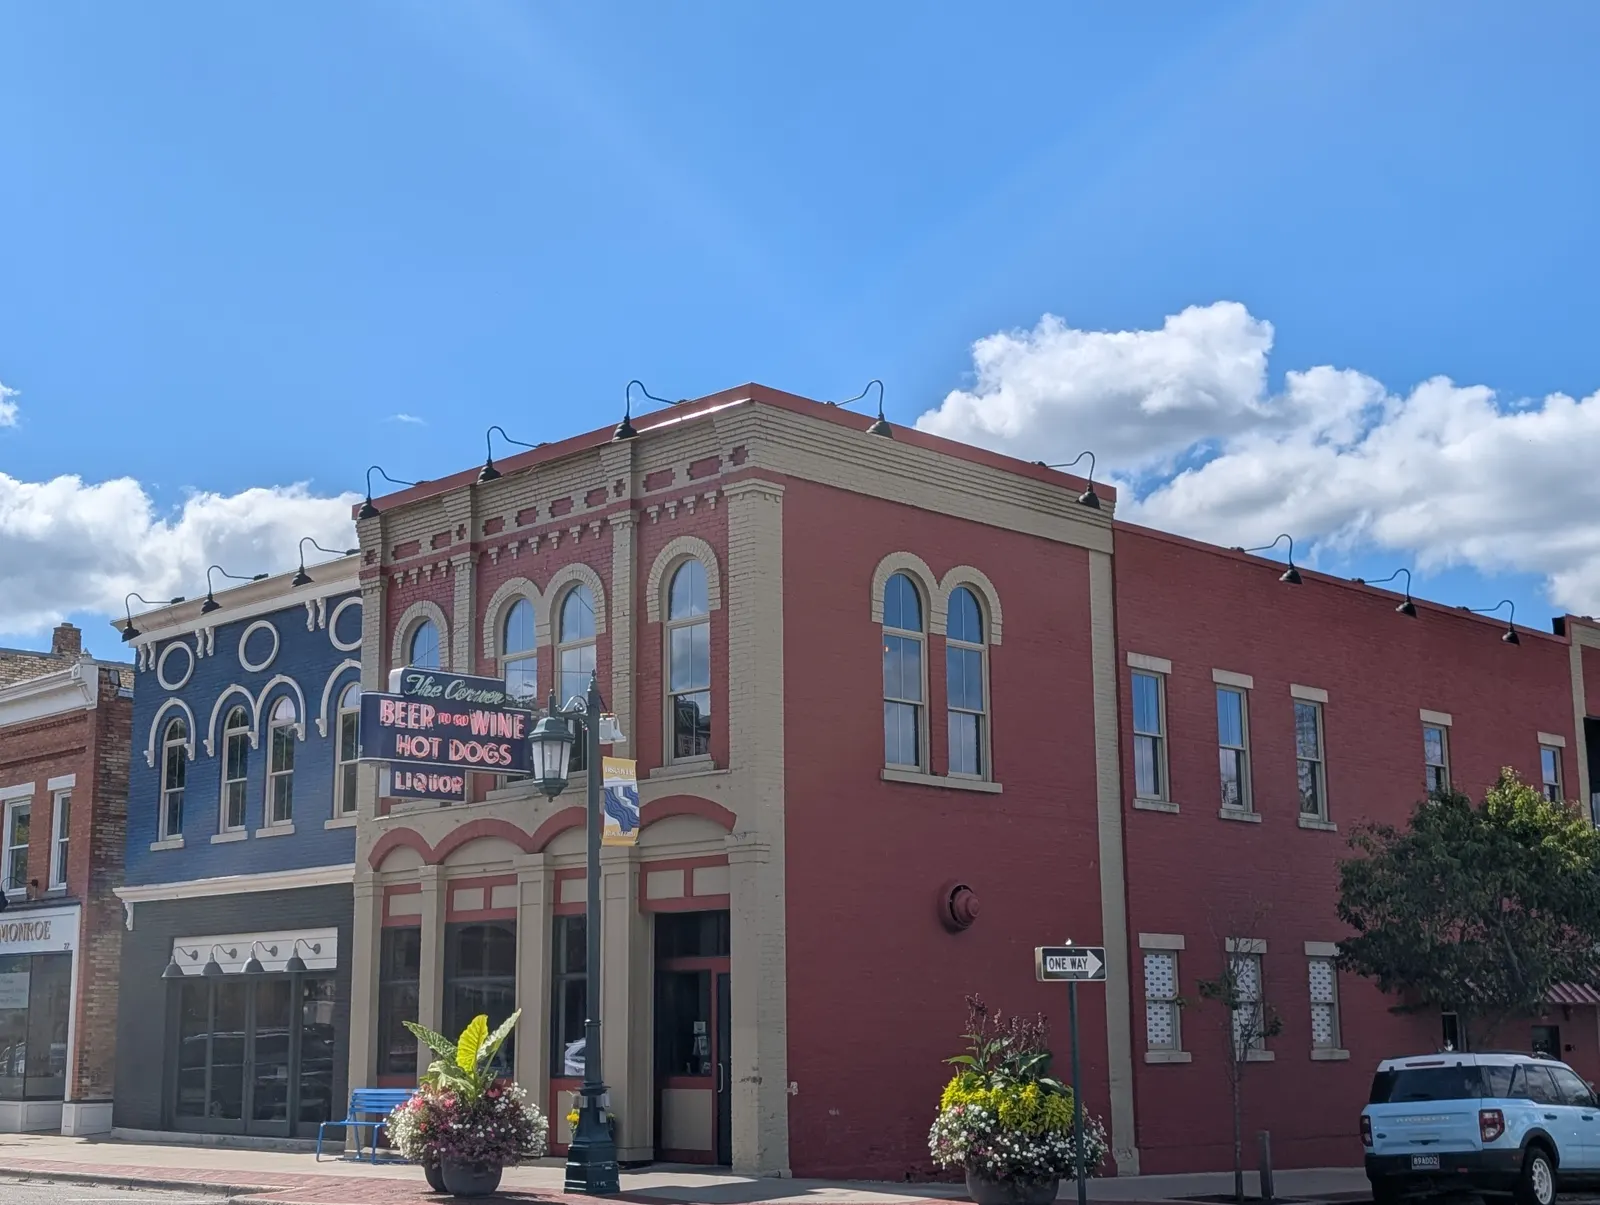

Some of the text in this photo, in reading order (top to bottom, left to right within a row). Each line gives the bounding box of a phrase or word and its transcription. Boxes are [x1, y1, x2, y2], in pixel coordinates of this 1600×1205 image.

[404, 674, 504, 704] The Corner
[380, 699, 436, 729] BEER
[437, 711, 452, 725] TO
[469, 709, 525, 739] WINE
[396, 733, 512, 766] HOT DOGS
[395, 771, 464, 795] LIQUOR
[0, 920, 52, 943] MONROE
[1048, 957, 1088, 970] ONE WAY
